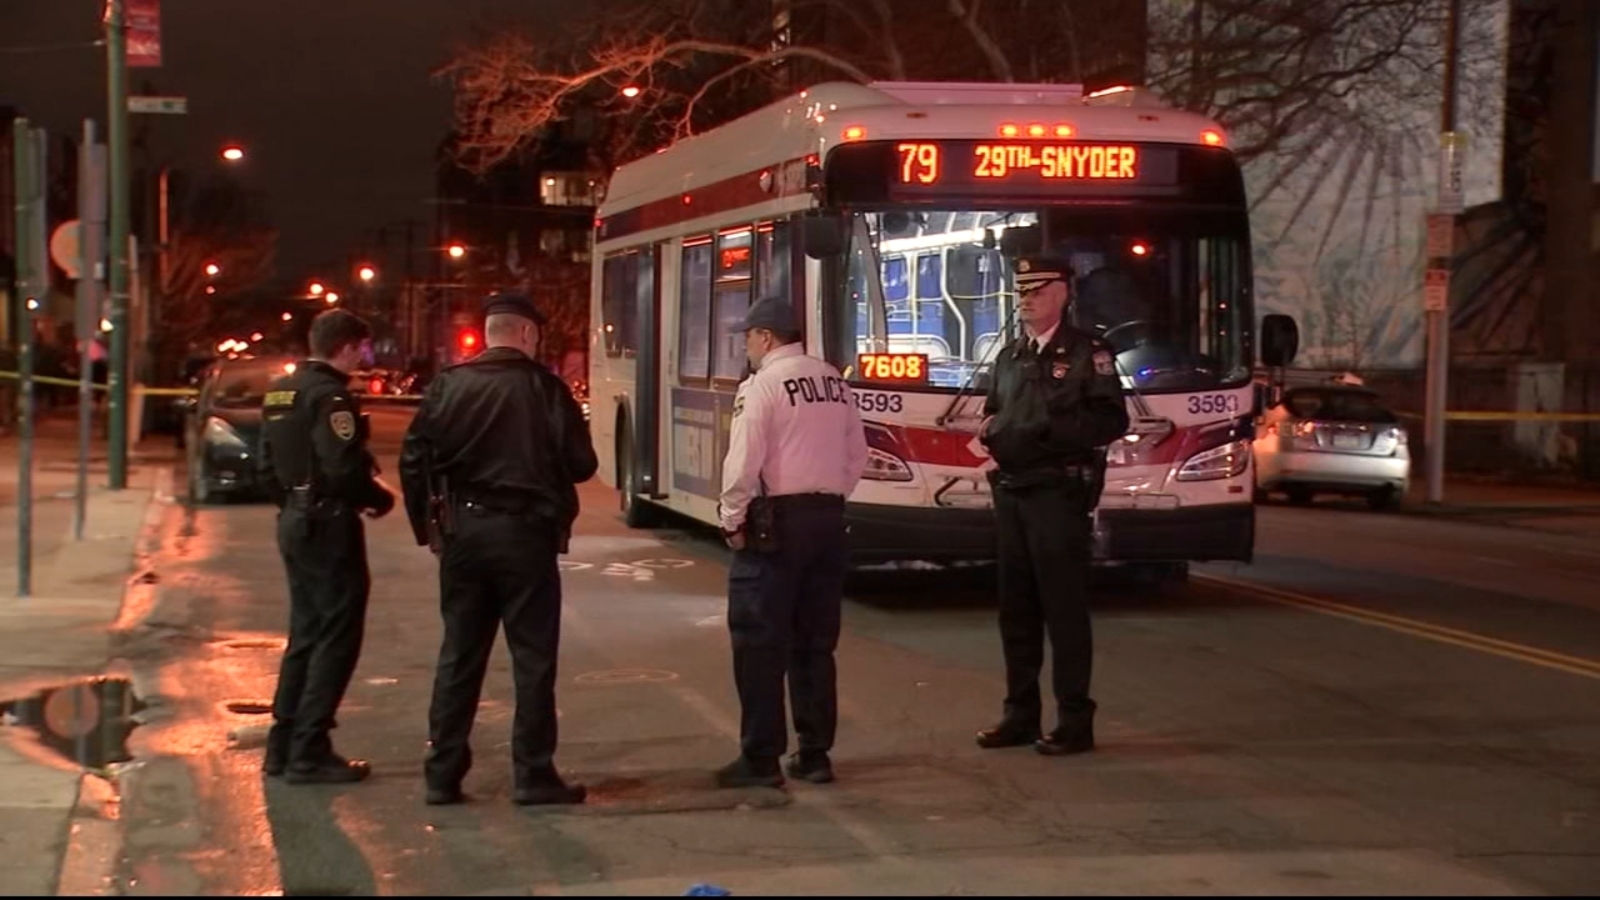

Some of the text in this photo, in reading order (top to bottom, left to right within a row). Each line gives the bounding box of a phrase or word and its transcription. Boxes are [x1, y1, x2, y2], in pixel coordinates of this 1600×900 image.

[898, 143, 1137, 183] 79 29TH-SNYDER
[860, 355, 921, 378] 7608
[783, 375, 849, 406] POLICE
[1188, 394, 1239, 414] 3593
